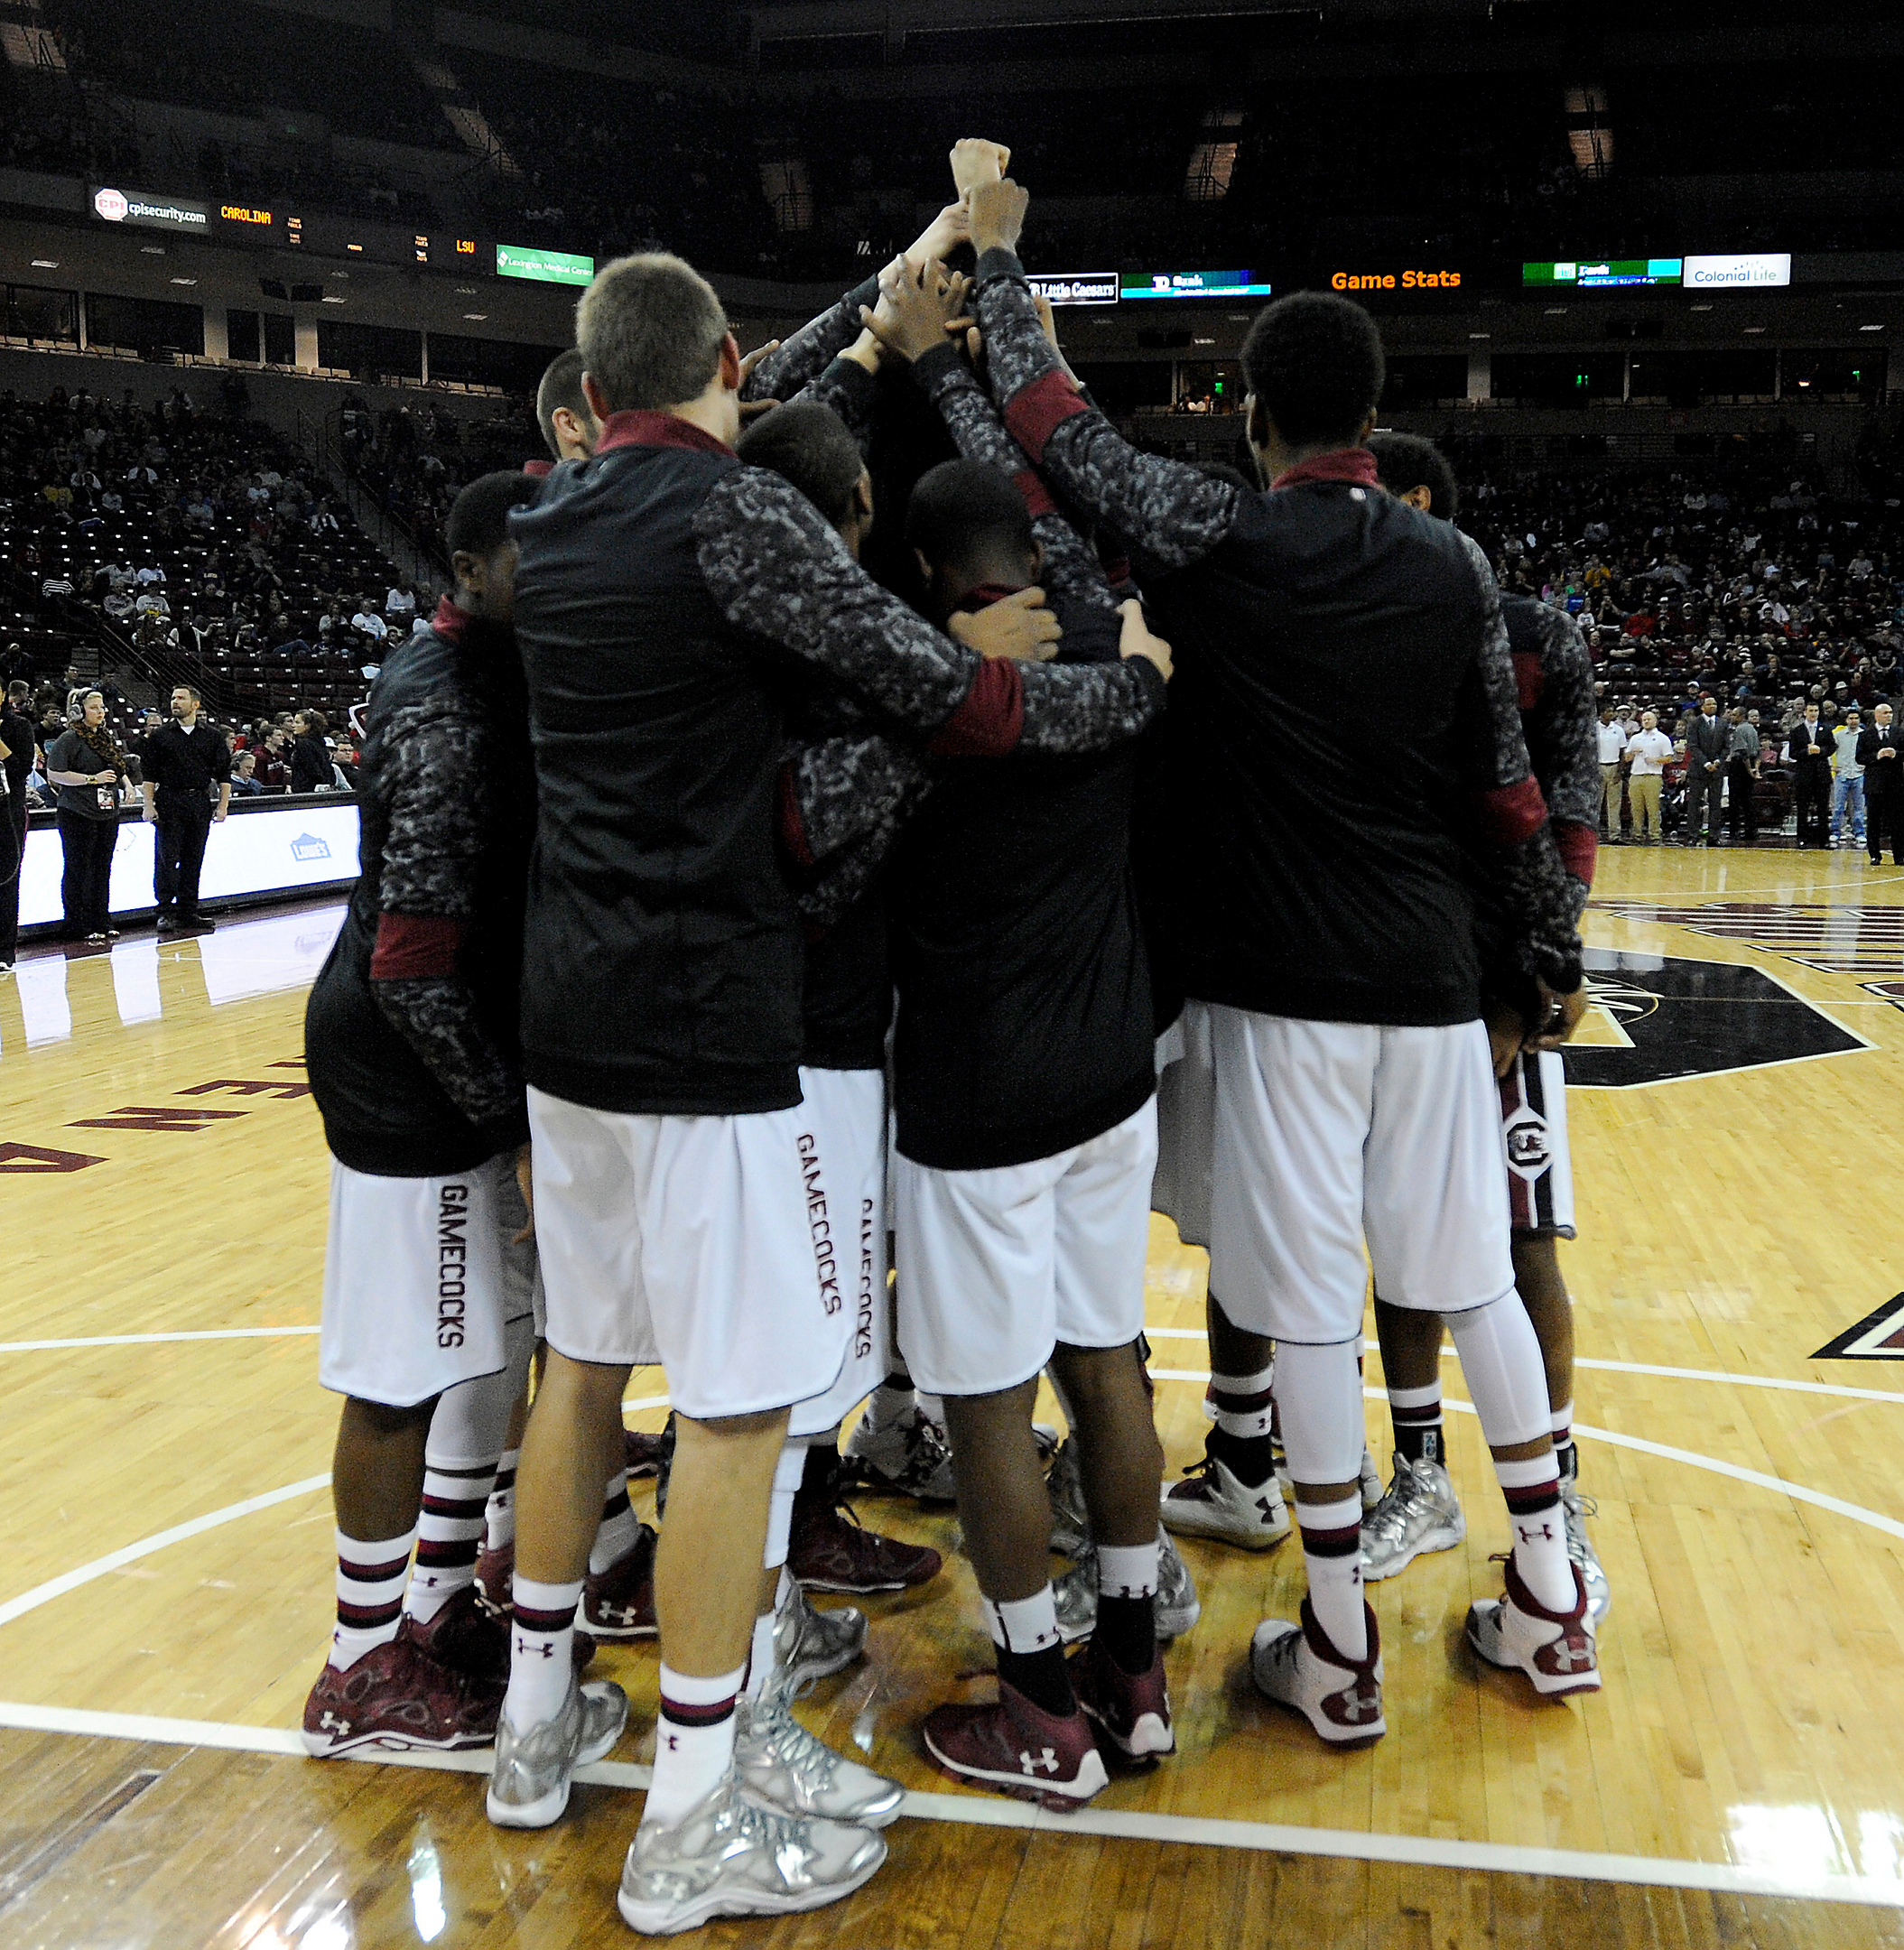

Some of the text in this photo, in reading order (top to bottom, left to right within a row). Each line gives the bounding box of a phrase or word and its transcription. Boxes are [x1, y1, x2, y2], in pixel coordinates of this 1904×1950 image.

[98, 199, 125, 210] CPI
[129, 202, 207, 224] cpisecurity.com
[220, 205, 272, 225] CAROLINA
[456, 239, 476, 254] LSU
[508, 258, 542, 270] Lexington
[543, 263, 570, 274] Medical
[1332, 271, 1461, 290] Game Stats
[1695, 270, 1777, 282] Colonial Life
[1041, 282, 1115, 298] Little Caesars
[795, 1133, 841, 1317] GAMECOCKS
[438, 1184, 469, 1348] GAMECOCKS
